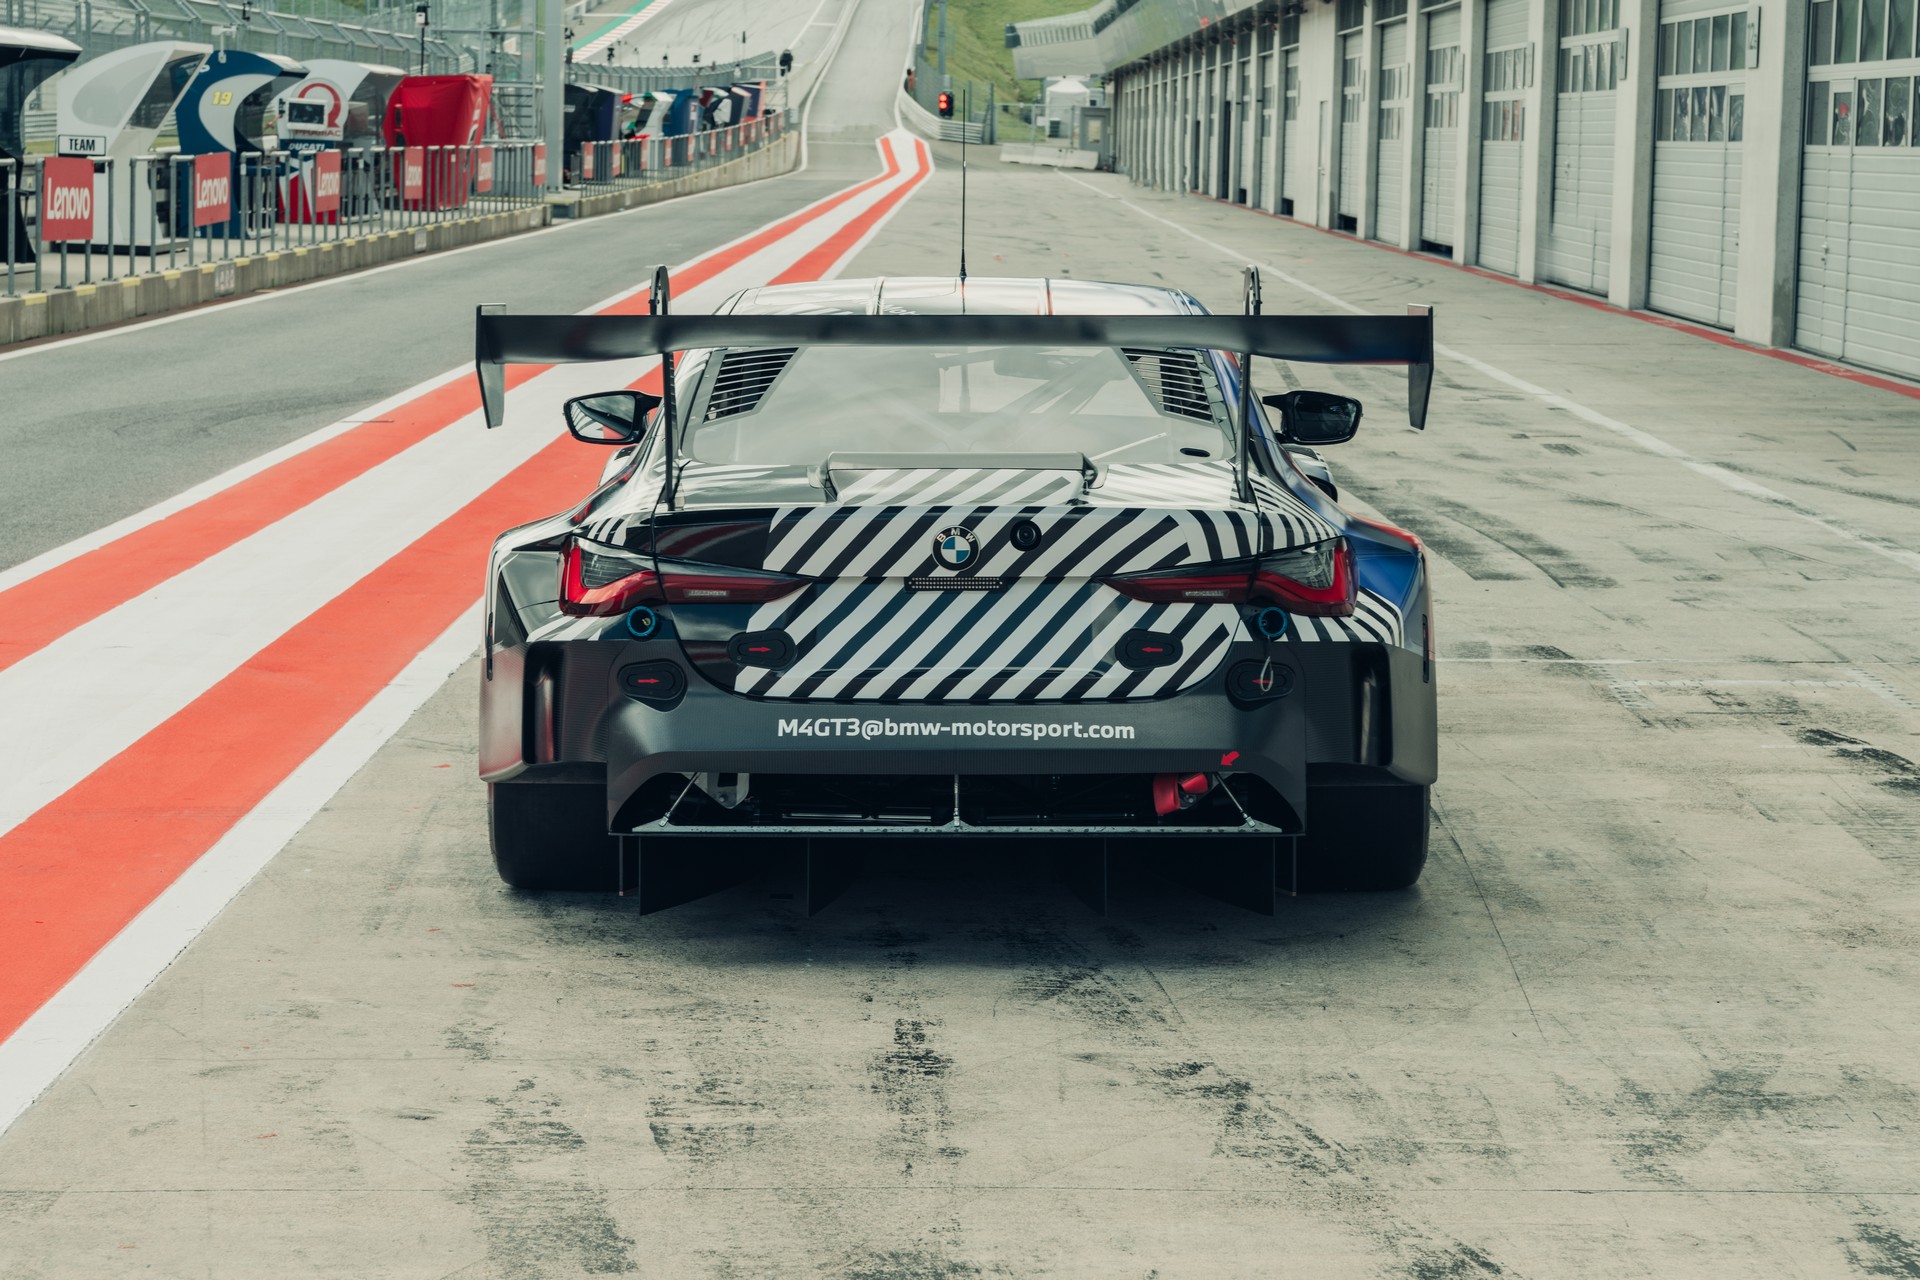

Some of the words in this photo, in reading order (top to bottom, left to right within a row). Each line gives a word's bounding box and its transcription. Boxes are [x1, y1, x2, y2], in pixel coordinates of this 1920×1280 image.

[212, 91, 233, 106] 19
[69, 138, 96, 151] TEAM
[288, 142, 326, 151] DUCATI
[196, 172, 230, 209] Lenovo
[317, 167, 340, 197] Lenovo
[46, 176, 91, 220] Lenovo
[777, 717, 1136, 741] M4GT3@bmw-motorsport.com
